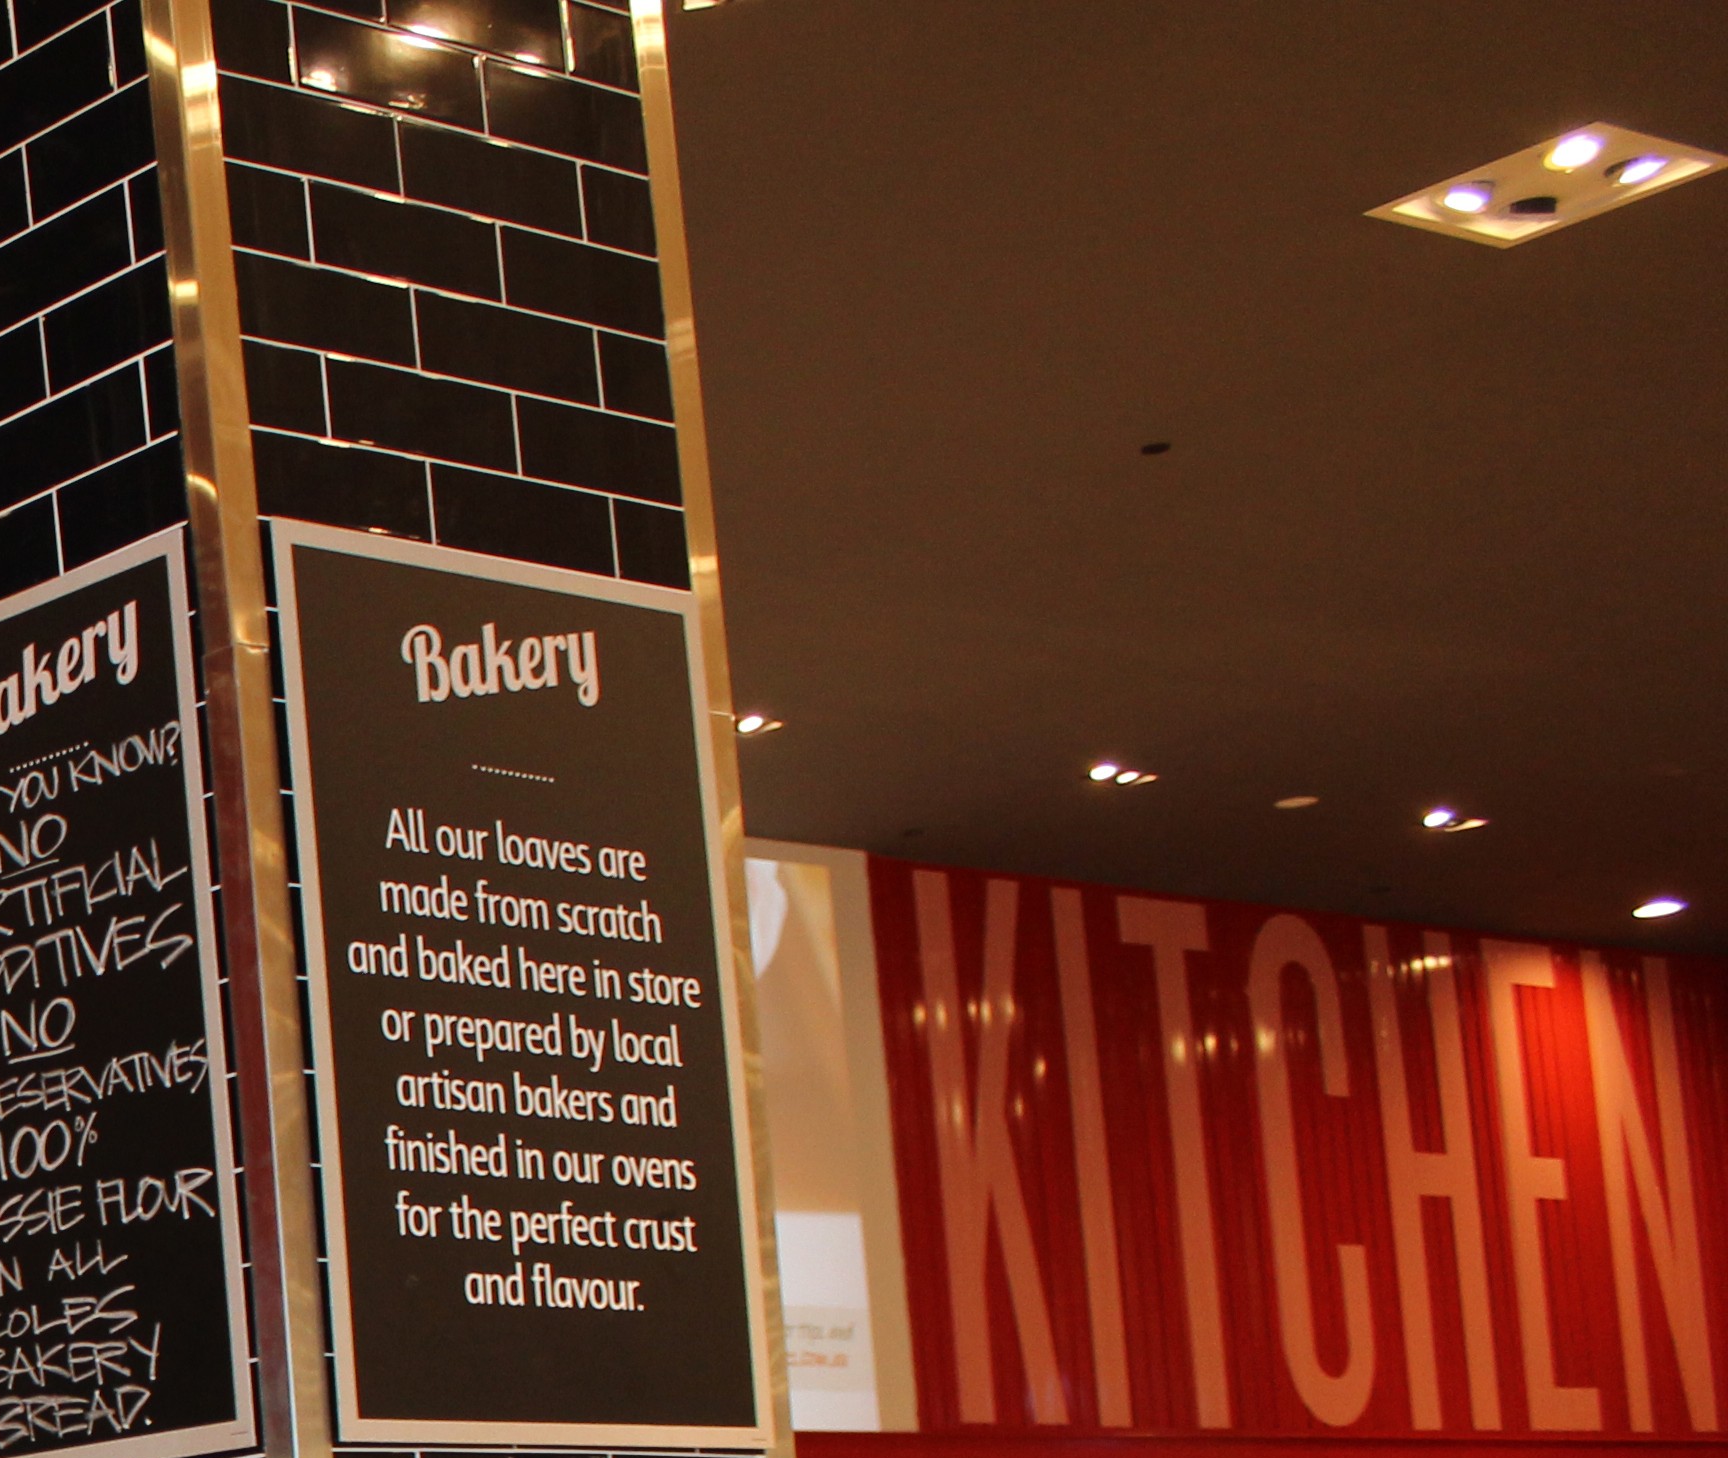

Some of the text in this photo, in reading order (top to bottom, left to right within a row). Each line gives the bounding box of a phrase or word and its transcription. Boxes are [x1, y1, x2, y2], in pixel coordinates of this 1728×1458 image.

[401, 622, 600, 707] Bakery
[69, 720, 181, 792] KNOW?
[386, 808, 647, 881] All our loaves are
[380, 874, 663, 944] made from scratch
[348, 933, 701, 1008] and baked here in store
[1, 997, 75, 1057] NO
[381, 1008, 684, 1073] or prepared by local
[396, 1070, 677, 1128] artisan bakers and
[385, 1125, 697, 1191] finished in our ovens
[912, 868, 1718, 1432] KITCHEN
[97, 1168, 215, 1225] FLOUR
[395, 1190, 698, 1255] for the perfect crust
[48, 1239, 128, 1282] ALL
[465, 1261, 645, 1311] and flavour.
